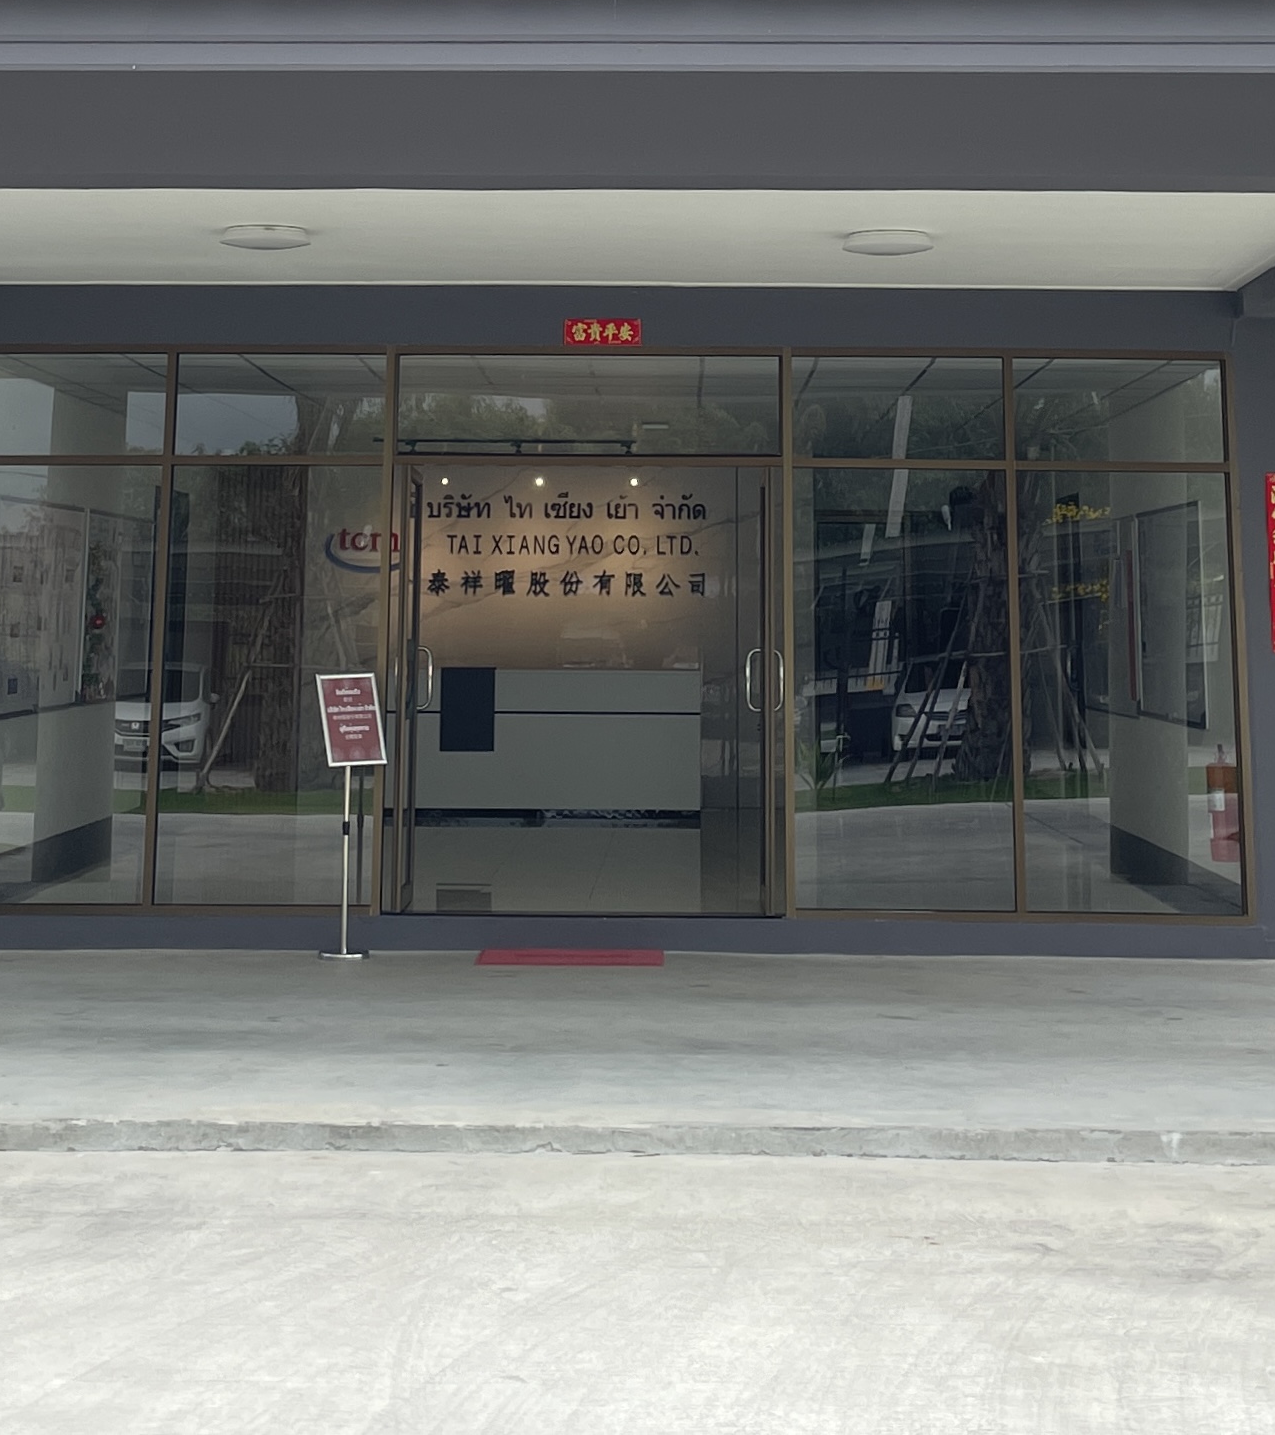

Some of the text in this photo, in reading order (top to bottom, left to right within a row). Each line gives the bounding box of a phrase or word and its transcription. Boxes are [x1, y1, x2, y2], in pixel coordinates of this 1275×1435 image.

[426, 493, 491, 520] บริษัท
[503, 495, 533, 520] ไท
[651, 493, 707, 520] จำกัด
[446, 534, 483, 555] TAI
[426, 568, 707, 598] 泰祥曜股份有限公司
